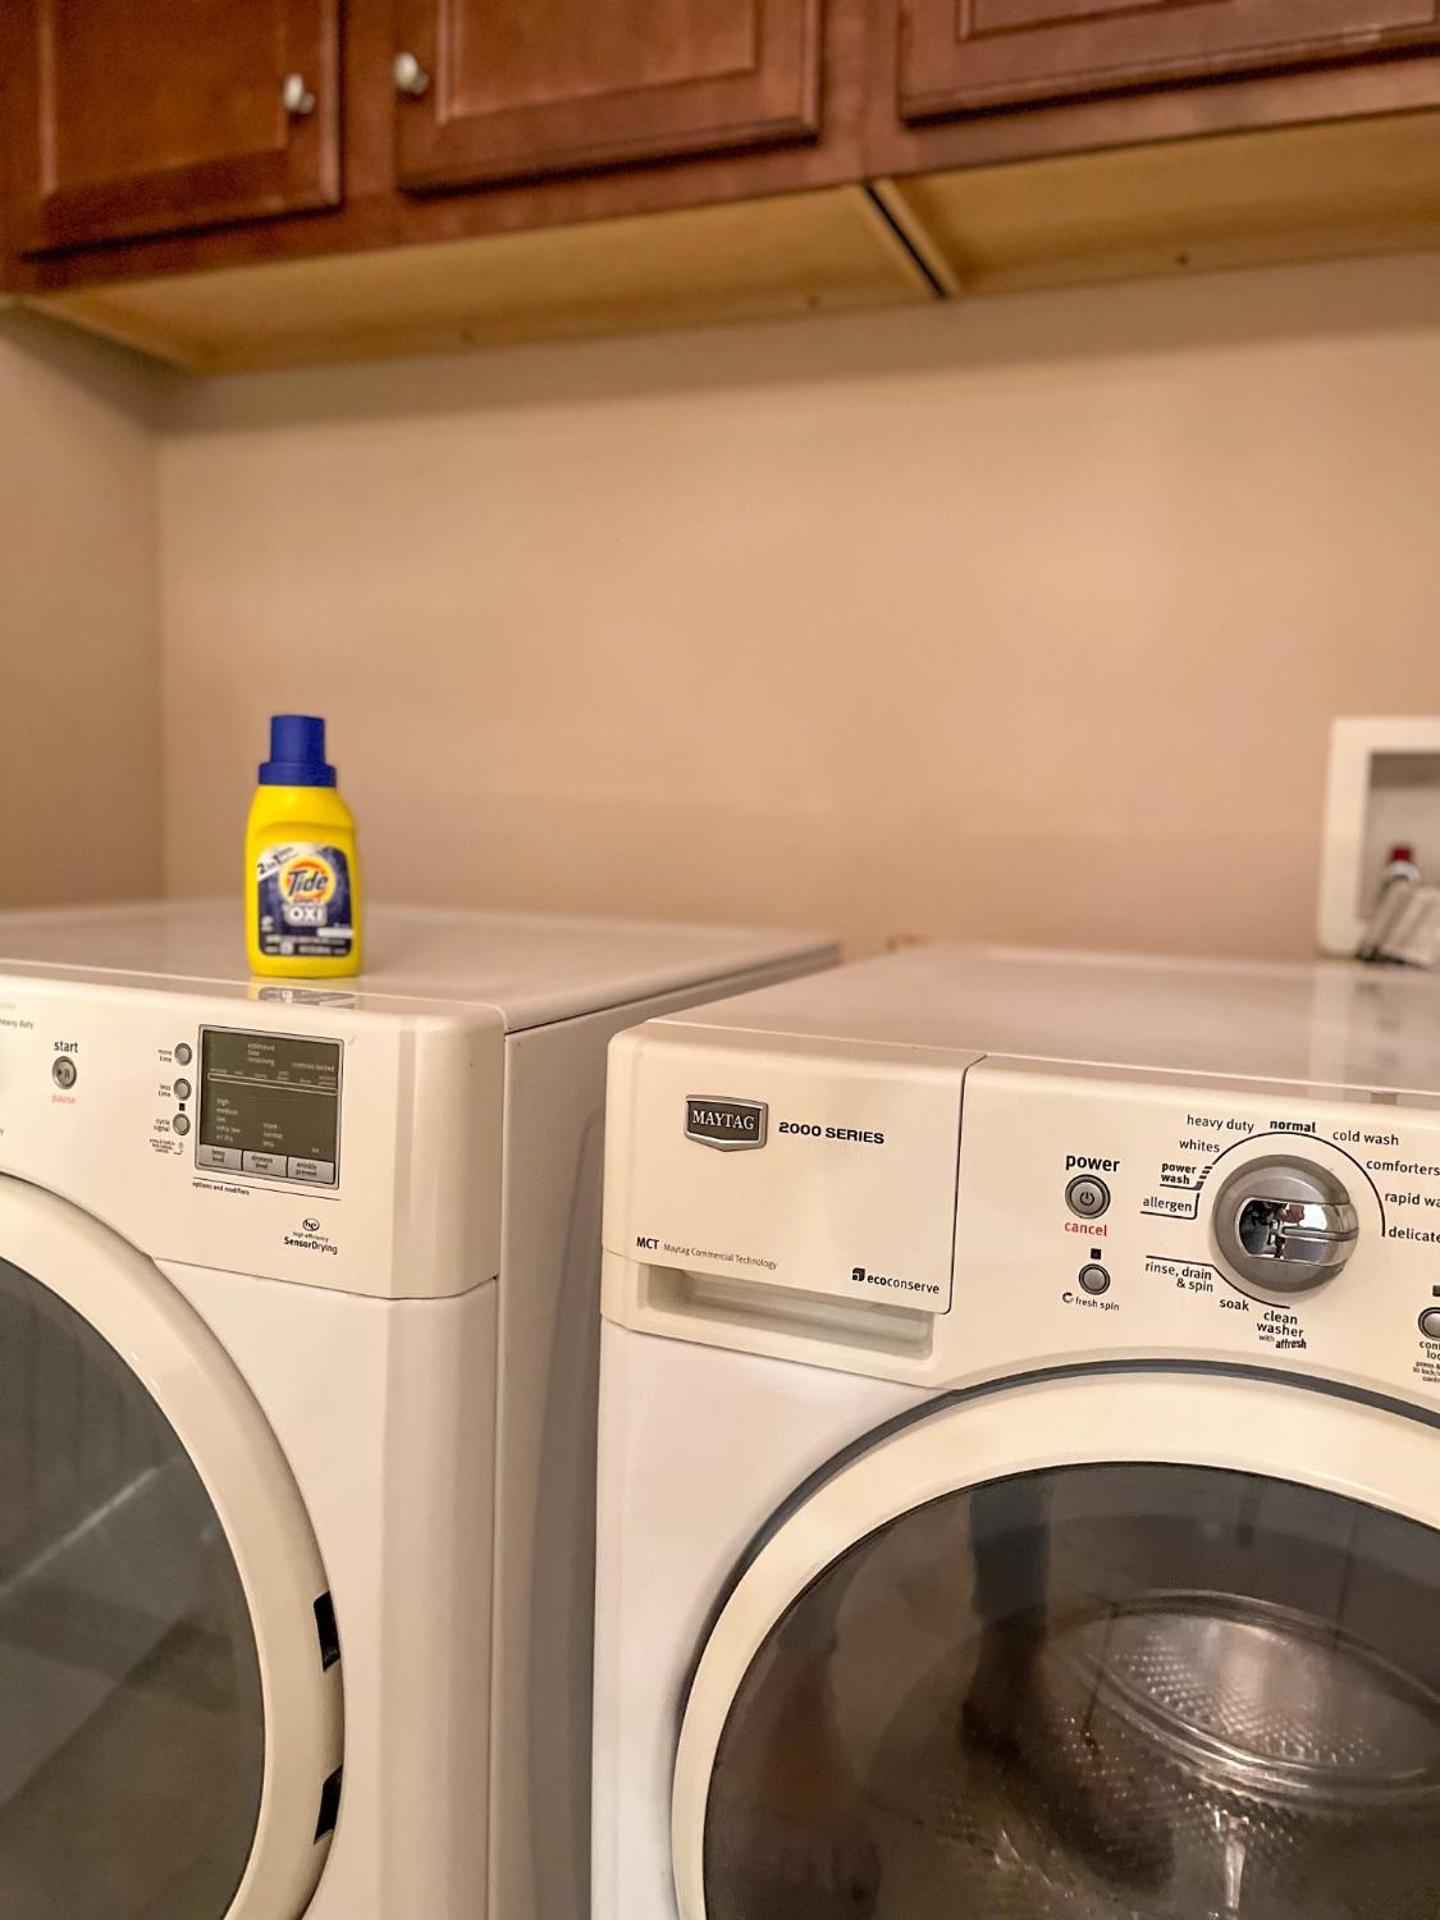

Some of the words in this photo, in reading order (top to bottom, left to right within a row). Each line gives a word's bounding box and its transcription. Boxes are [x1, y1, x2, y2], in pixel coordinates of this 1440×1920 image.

[288, 870, 329, 896] Tide
[289, 905, 322, 921] OXI
[54, 1040, 79, 1053] start
[159, 1055, 172, 1063] time
[52, 1094, 76, 1104] pause
[693, 1109, 756, 1130] MAYTAG
[1187, 1114, 1224, 1131] heavy
[1226, 1118, 1255, 1134] duty
[1269, 1119, 1316, 1134] normal
[779, 1121, 822, 1137] 2000
[825, 1127, 885, 1144] SERIES
[1332, 1130, 1361, 1142] cold
[1363, 1133, 1399, 1146] wash
[1179, 1138, 1221, 1154] whites
[1065, 1154, 1121, 1172] power
[1161, 1161, 1198, 1175] power
[1366, 1159, 1440, 1176] comforters
[1160, 1172, 1191, 1185] wash
[192, 1182, 212, 1190] options
[224, 1187, 250, 1196] modifiers
[1142, 1195, 1193, 1213] allergen
[1384, 1191, 1421, 1207] rapid
[1064, 1221, 1108, 1237] cancel
[284, 1236, 338, 1255] SensorDrying
[636, 1236, 660, 1250] MCT
[663, 1243, 690, 1257] Maytag
[691, 1247, 735, 1261] Commercial
[735, 1254, 778, 1271] Technology
[1145, 1262, 1180, 1278] rinse,
[1181, 1266, 1213, 1281] drain
[867, 1274, 941, 1295] ecoconserve
[1176, 1278, 1187, 1289] &
[1188, 1280, 1214, 1293] spin
[1075, 1295, 1098, 1308] fresh
[1100, 1300, 1120, 1311] spin
[1219, 1299, 1250, 1312] soak
[1263, 1310, 1298, 1325] clean
[1256, 1321, 1304, 1338] washer
[1258, 1334, 1276, 1343] with
[1275, 1338, 1307, 1349] affresh
